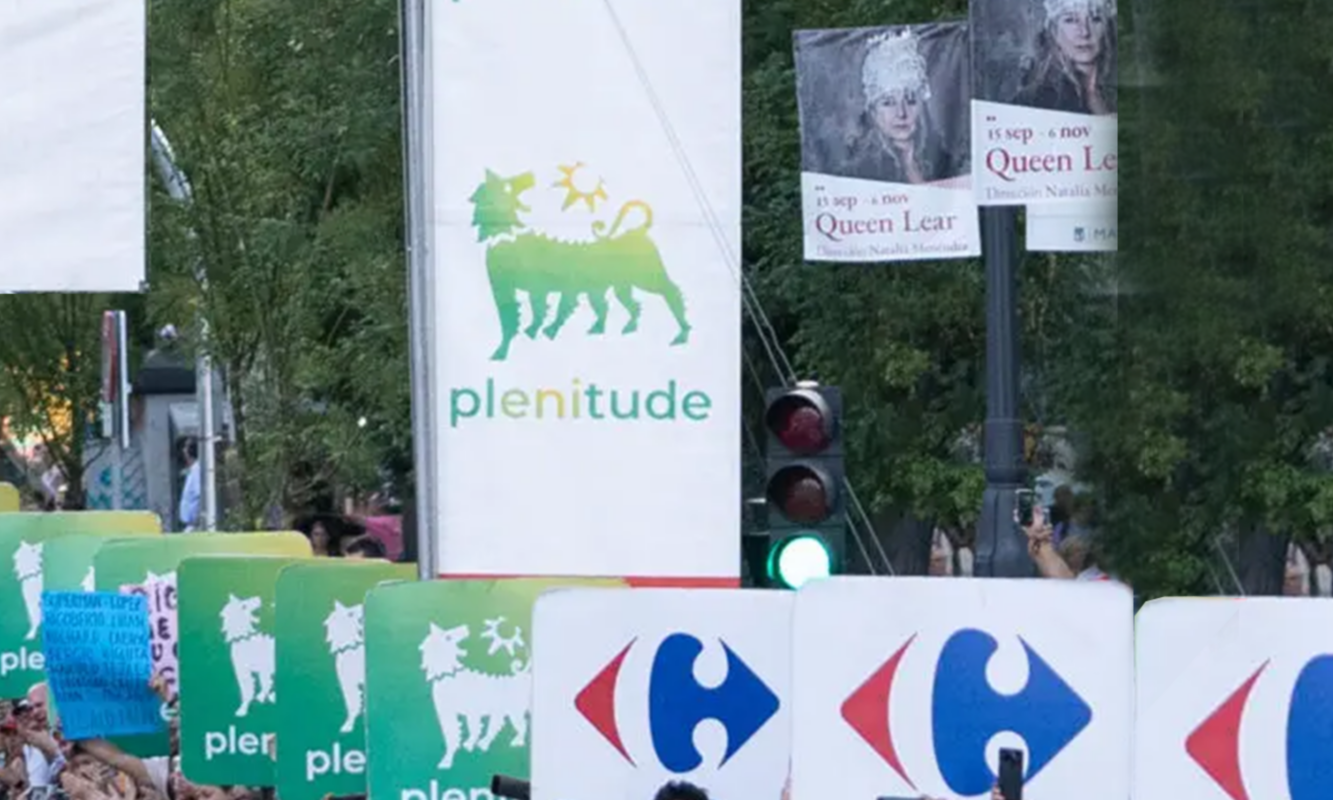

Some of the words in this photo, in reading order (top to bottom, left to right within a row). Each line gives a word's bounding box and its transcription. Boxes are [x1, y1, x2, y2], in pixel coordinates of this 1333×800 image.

[1005, 128, 1033, 144] sep
[1060, 126, 1090, 138] nov
[986, 147, 1073, 181] Queen
[815, 212, 893, 242] Queen
[904, 210, 957, 233] Lear
[450, 378, 712, 429] plenitude
